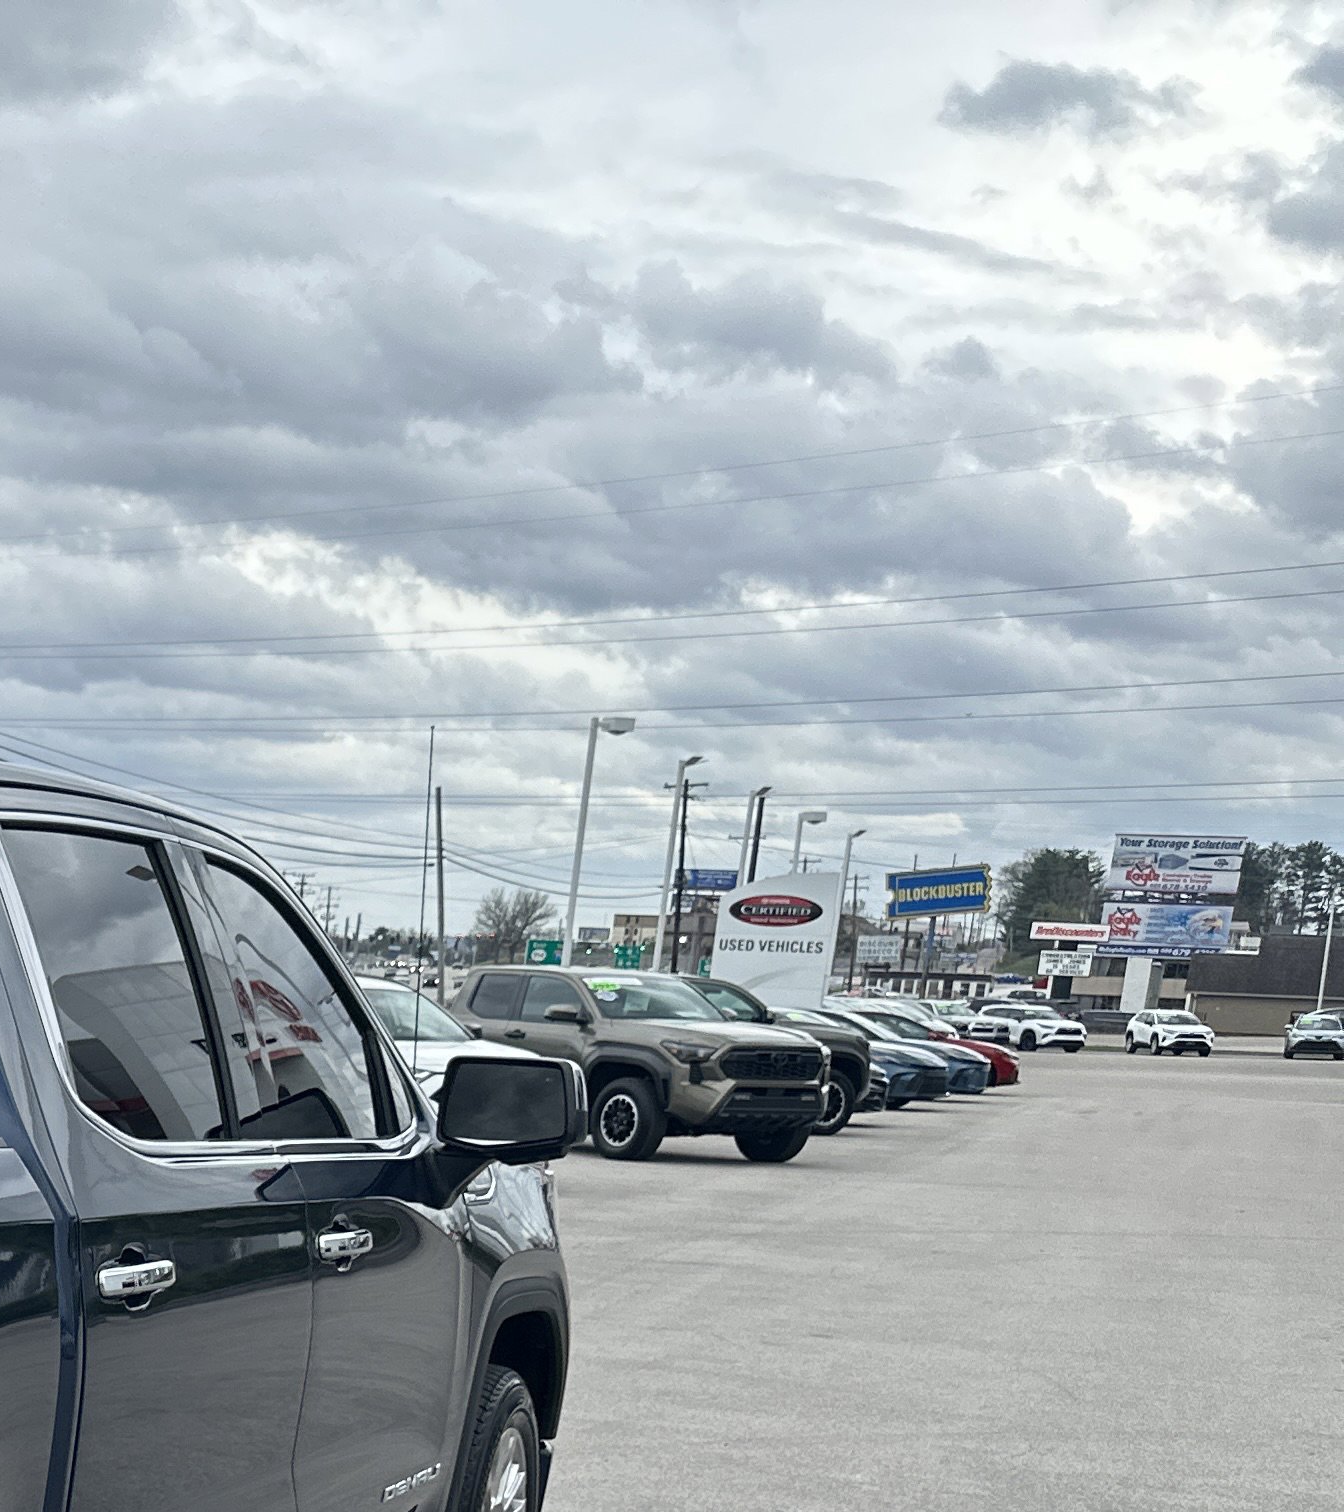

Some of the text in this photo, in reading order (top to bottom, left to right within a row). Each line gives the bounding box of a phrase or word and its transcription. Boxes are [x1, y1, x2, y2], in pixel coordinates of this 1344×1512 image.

[1119, 837, 1244, 850] Your Storage Solution!
[898, 881, 984, 903] BLOCKBUSTER
[740, 904, 812, 916] CERTIFIED
[719, 938, 824, 954] USED VEHICLES
